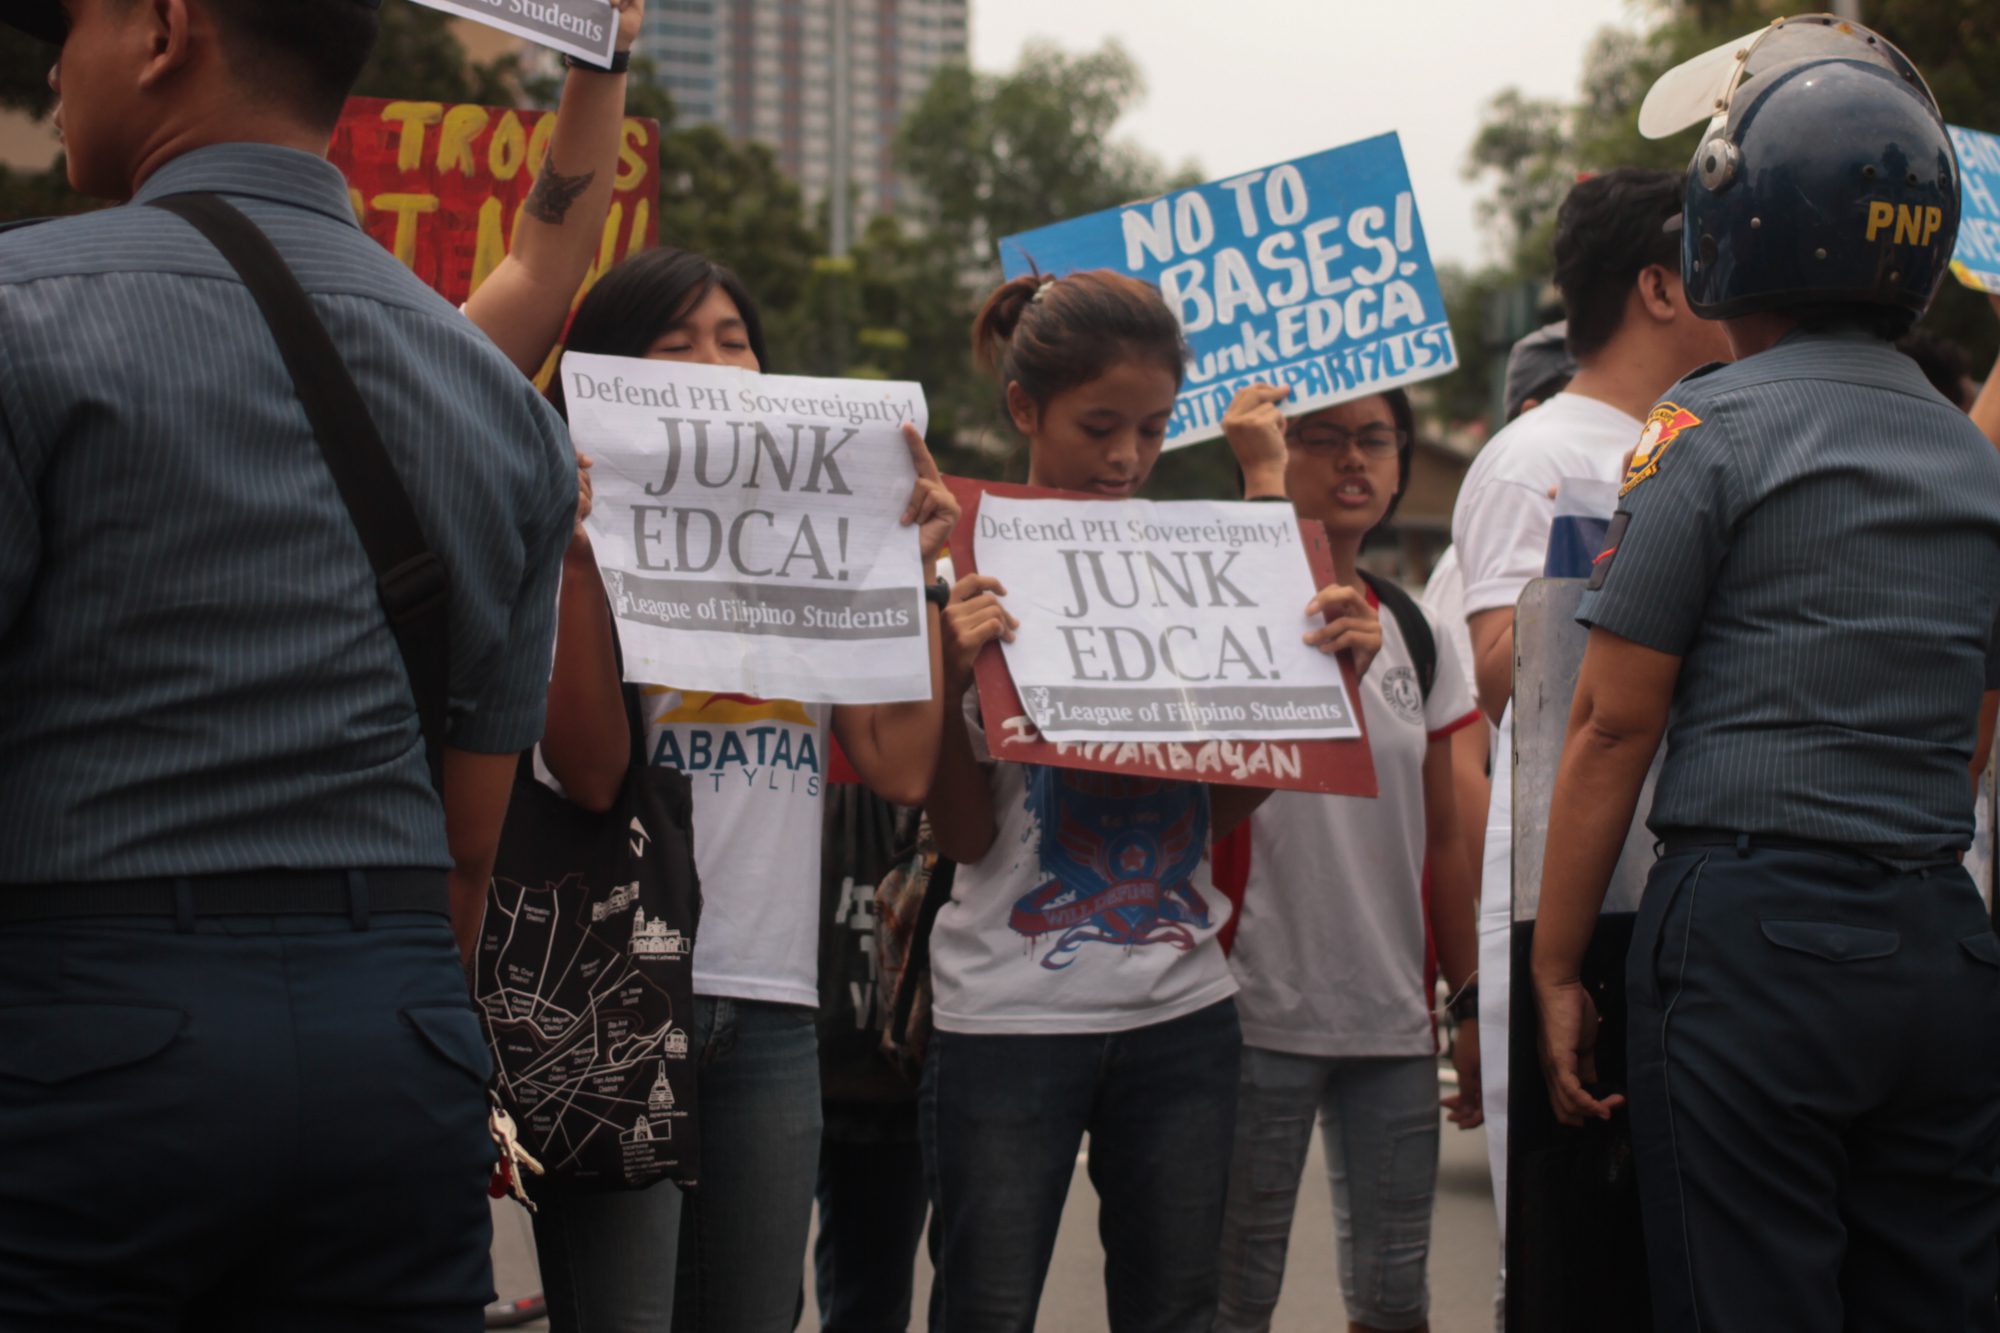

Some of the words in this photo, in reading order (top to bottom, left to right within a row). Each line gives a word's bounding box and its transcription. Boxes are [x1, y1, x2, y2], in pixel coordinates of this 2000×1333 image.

[508, 0, 603, 42] Students
[380, 100, 649, 192] TROOS
[1121, 191, 1215, 271] NO
[1220, 164, 1308, 238] TO
[1865, 200, 1943, 247] PNP
[1159, 191, 1419, 333] BASES!
[1185, 319, 1278, 384] unk
[1275, 279, 1426, 359] EDCA
[1281, 325, 1455, 404] PARTYLIST
[572, 372, 680, 409] Defend
[687, 385, 732, 412] PH
[738, 389, 917, 428] Sovereignty!
[644, 416, 860, 497] JUNK
[629, 504, 850, 582] EDCA!
[980, 513, 1075, 542] Defend
[1082, 519, 1120, 543] PH
[1129, 519, 1293, 552] Sovereignty!
[629, 592, 693, 622] League
[697, 597, 719, 620] of
[721, 599, 796, 628] Filipino
[803, 604, 910, 629] Students
[1057, 549, 1259, 619] JUNK
[1056, 625, 1283, 683] EDCA!
[1056, 702, 1132, 726] League
[1138, 701, 1162, 722] of
[1168, 701, 1246, 726] Filipino
[1252, 700, 1342, 722] Students
[651, 726, 820, 774] ABATAA
[684, 767, 820, 797] TYLIS
